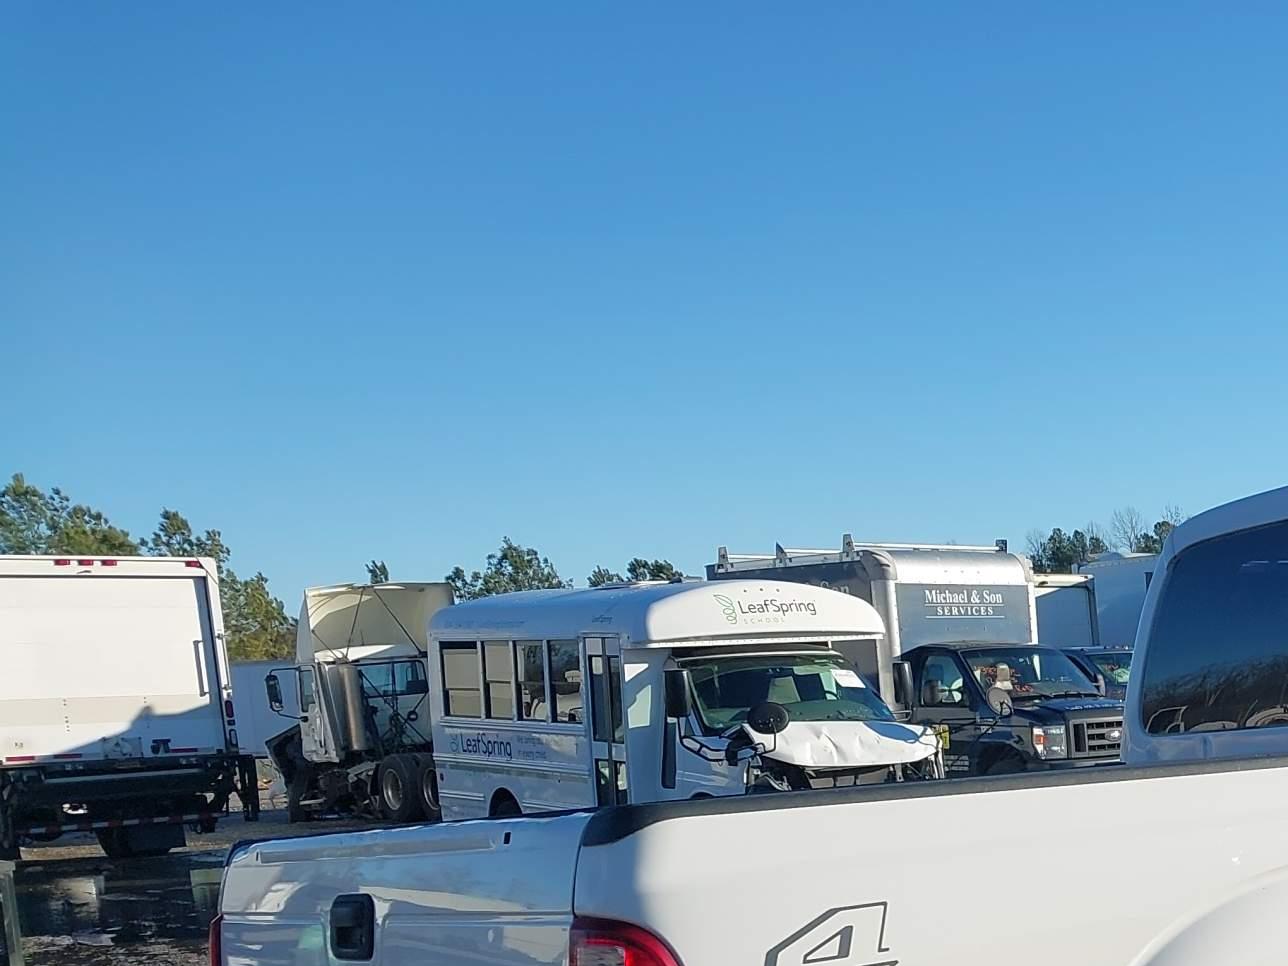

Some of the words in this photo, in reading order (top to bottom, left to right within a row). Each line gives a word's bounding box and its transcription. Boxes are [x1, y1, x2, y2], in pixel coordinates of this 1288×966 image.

[924, 589, 968, 603] Michael
[970, 589, 980, 603] &
[983, 589, 1003, 603] Son
[737, 599, 817, 616] LeafSpring
[936, 606, 994, 615] SERVICES
[743, 617, 785, 625] SCHOOL
[460, 732, 513, 760] LeafSpring
